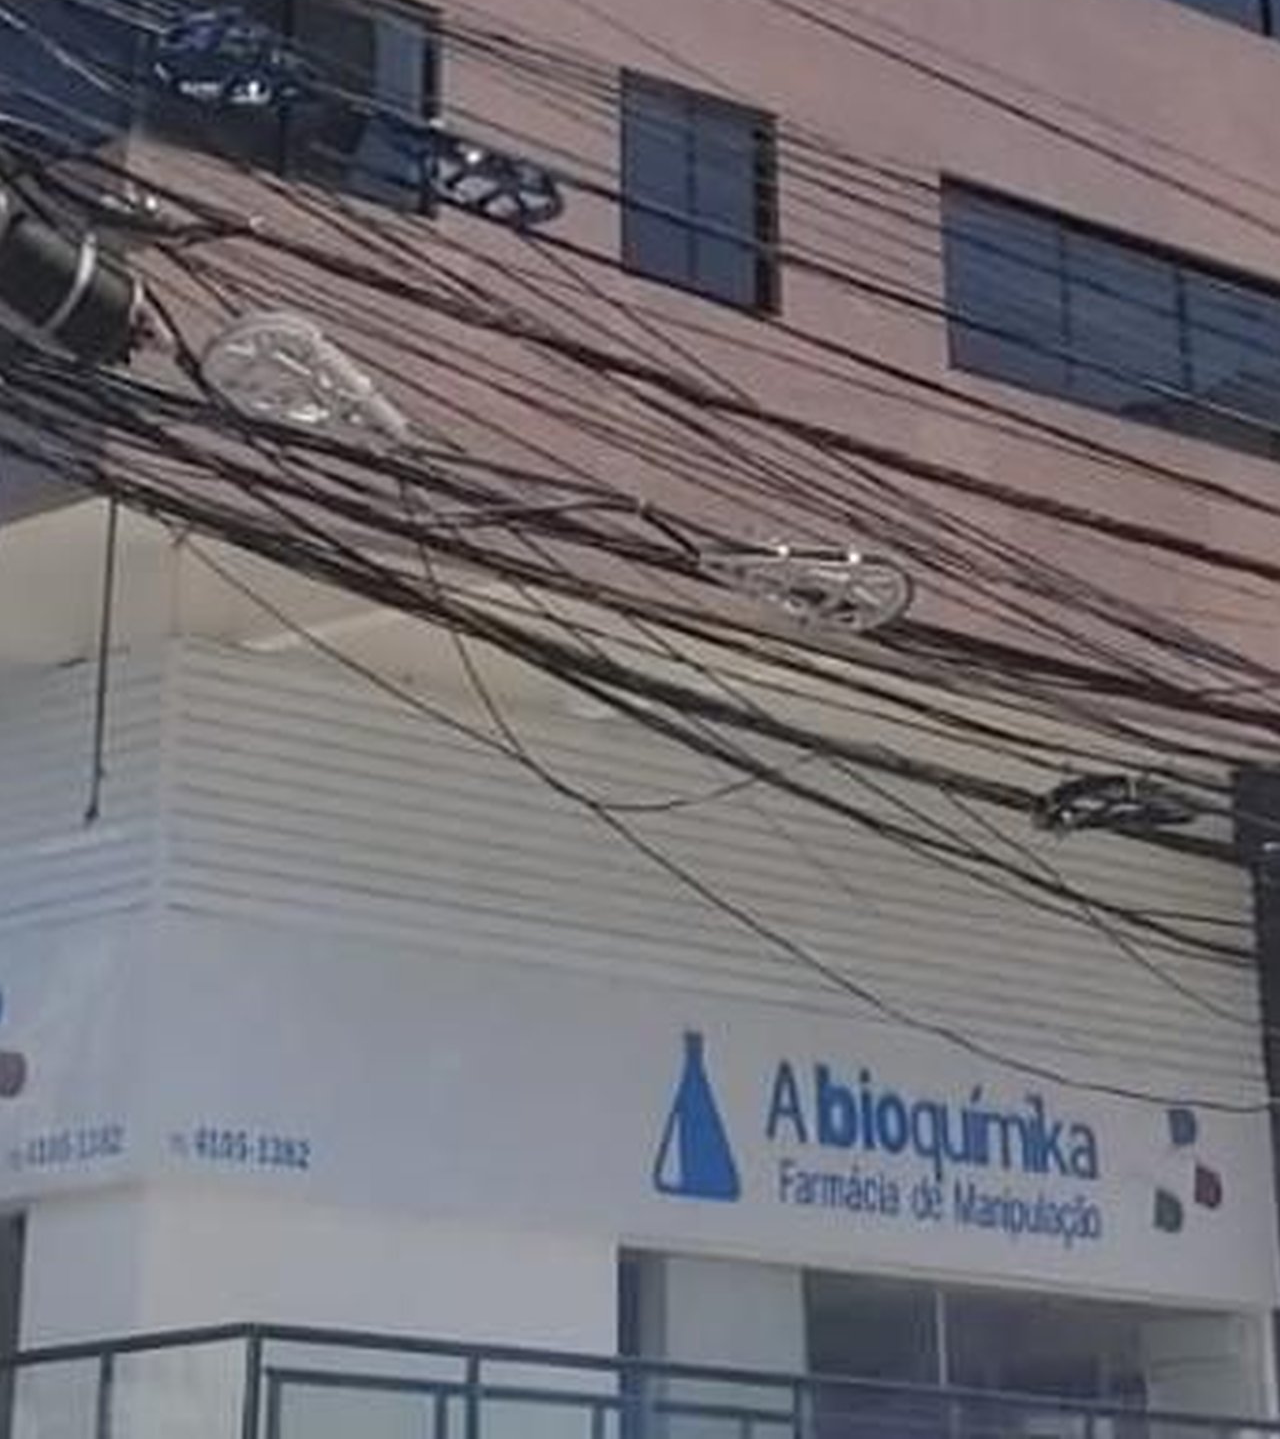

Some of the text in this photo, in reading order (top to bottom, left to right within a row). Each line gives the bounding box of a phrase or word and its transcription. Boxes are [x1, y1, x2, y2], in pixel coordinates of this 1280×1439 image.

[777, 1157, 1104, 1250] Farmácia de Manipulação
